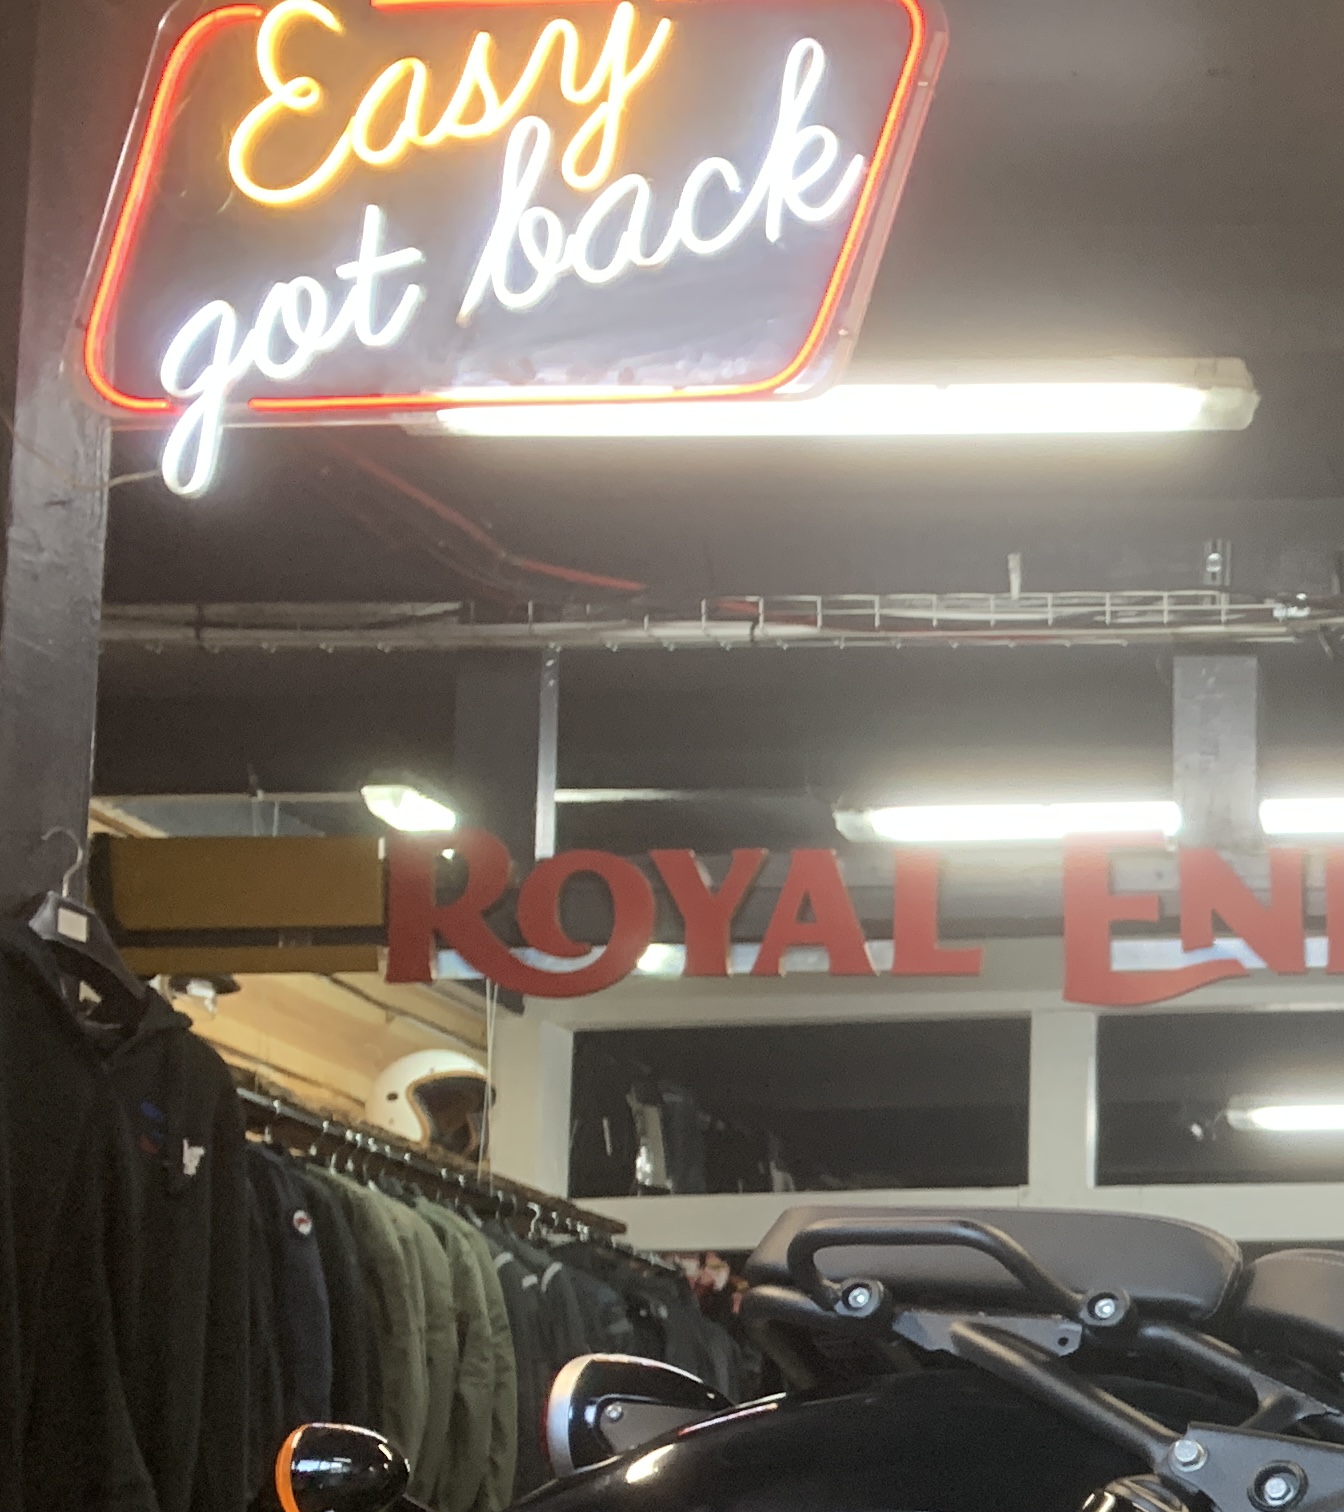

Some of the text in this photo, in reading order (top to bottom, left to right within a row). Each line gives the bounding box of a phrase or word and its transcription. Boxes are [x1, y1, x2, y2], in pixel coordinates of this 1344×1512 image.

[227, 0, 672, 205] Easy
[159, 36, 866, 496] got back
[385, 826, 986, 999] ROYAL
